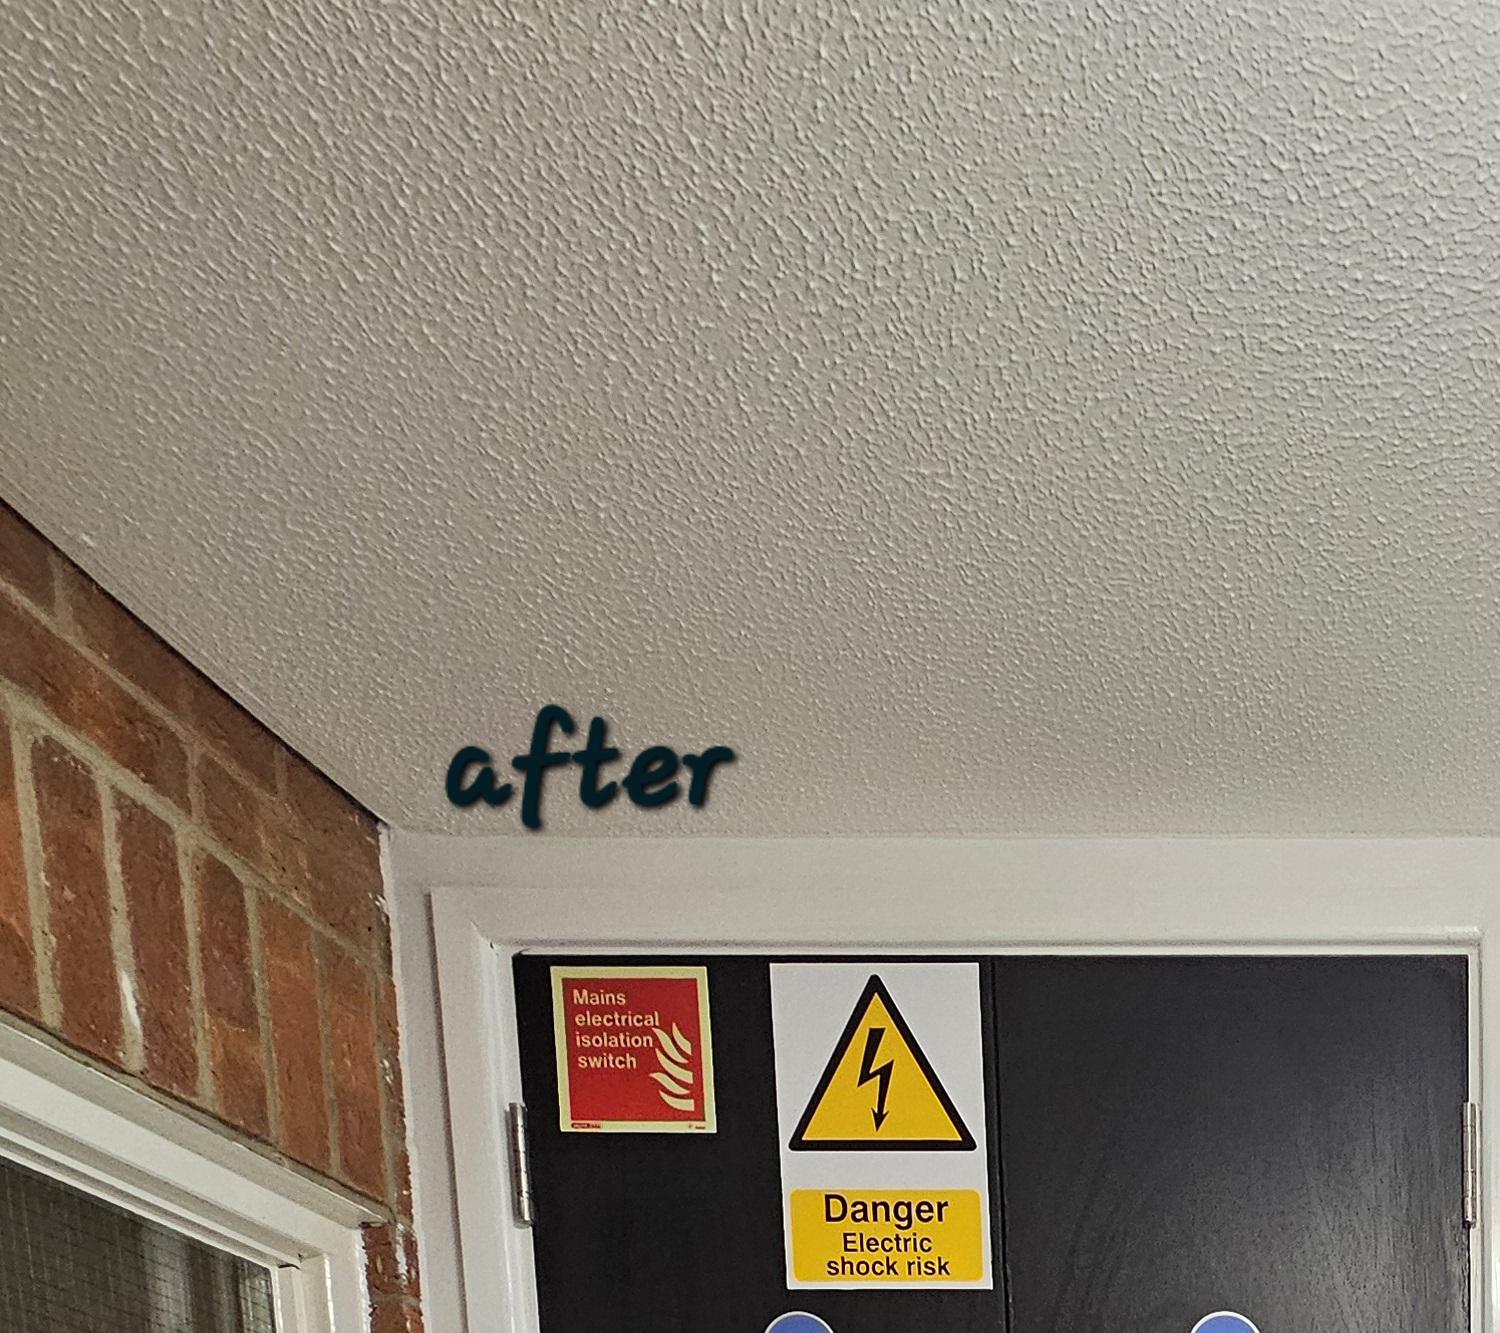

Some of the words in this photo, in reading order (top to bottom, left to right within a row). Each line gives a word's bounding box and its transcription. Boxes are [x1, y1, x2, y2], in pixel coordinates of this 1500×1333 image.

[572, 988, 627, 1006] Mains
[574, 1010, 660, 1028] electrical
[574, 1030, 654, 1048] isolation
[577, 1052, 637, 1070] switch
[824, 1193, 949, 1231] Danger
[842, 1232, 933, 1253] Electric
[826, 1255, 899, 1277] shock
[906, 1255, 951, 1277] risk
